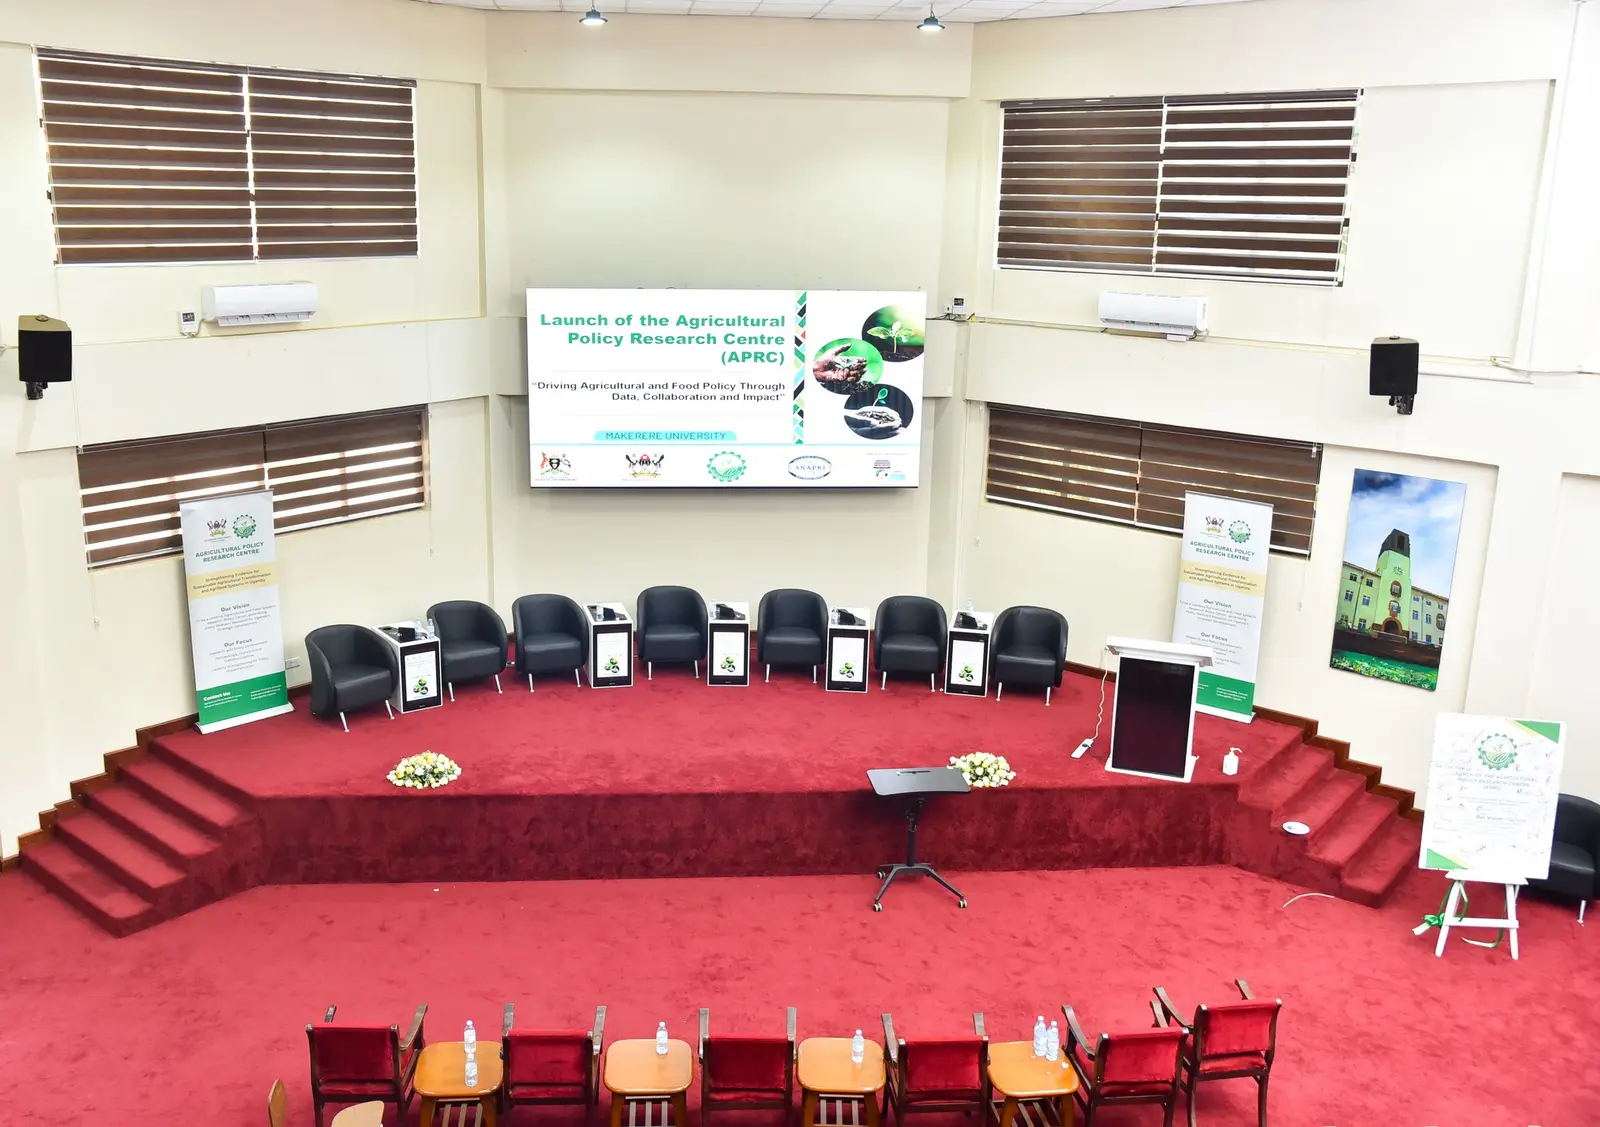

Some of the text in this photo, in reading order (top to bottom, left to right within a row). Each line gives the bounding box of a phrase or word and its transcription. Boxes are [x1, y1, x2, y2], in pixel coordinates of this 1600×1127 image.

[540, 314, 785, 330] Launch of the Agricultural
[568, 332, 785, 347] Policy Research Centre
[721, 351, 785, 366] (APRC)
[580, 381, 645, 391] Agricultural
[648, 382, 668, 390] and
[672, 382, 700, 390] Food
[702, 382, 736, 392] Policy
[740, 382, 786, 392] Through
[612, 393, 640, 401] Data,
[643, 393, 717, 401] Collaboration
[720, 393, 740, 401] and
[605, 432, 726, 440] MAKERERE UNIVERSITY
[195, 542, 264, 558] AGRICULTURAL POLICY
[203, 548, 260, 563] RESEARCH CENTRE
[1190, 541, 1255, 556] AGRICULTURAL POLICY
[1196, 547, 1250, 562] RESEARCH CENTRE
[1214, 600, 1232, 608] Vision
[1211, 634, 1228, 642] Focus
[203, 693, 222, 702] Contact
